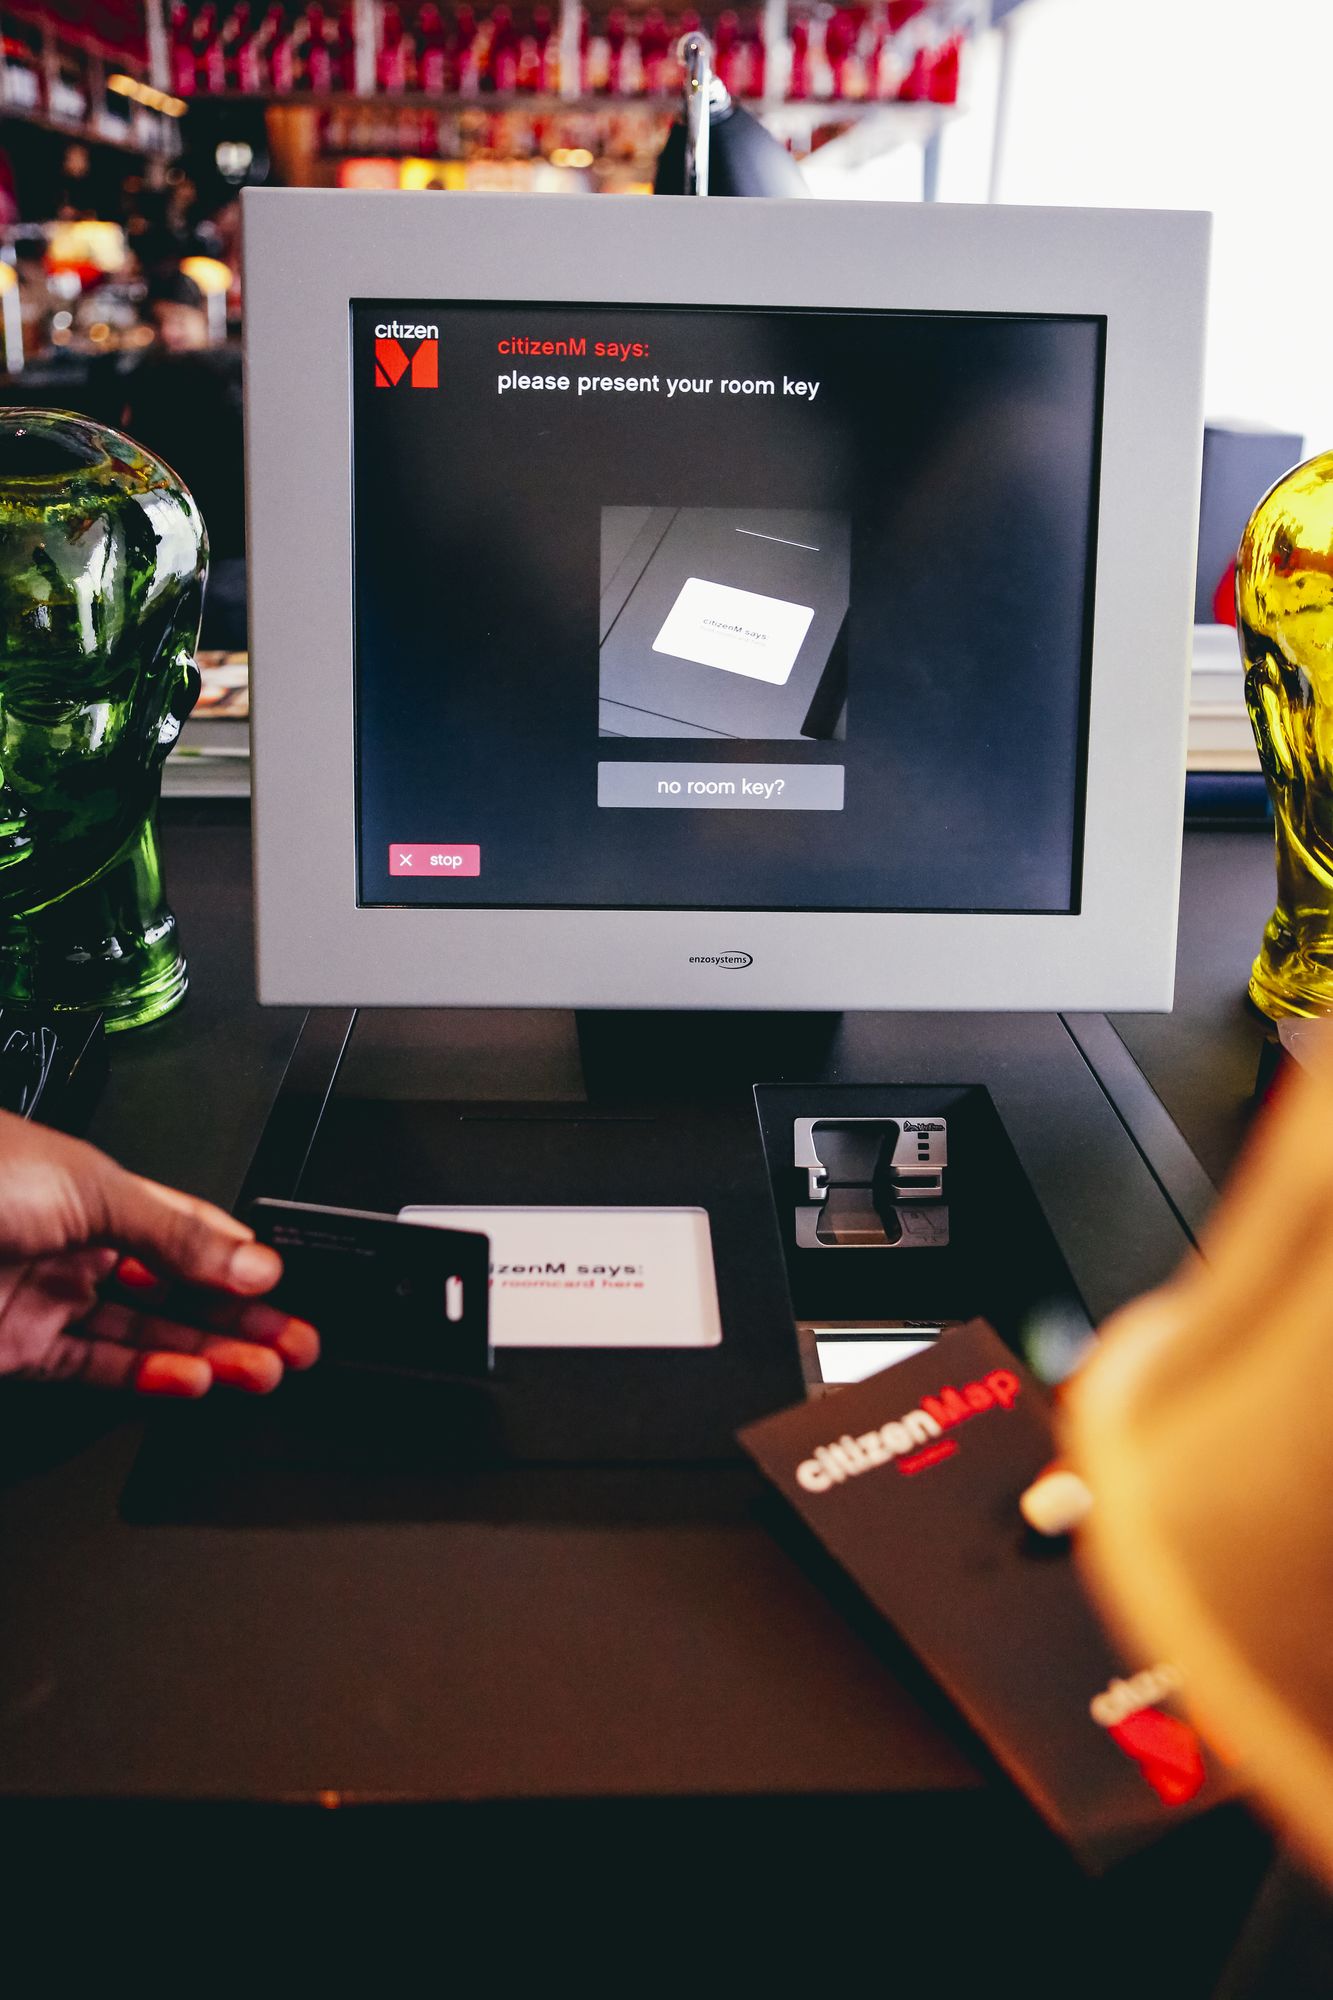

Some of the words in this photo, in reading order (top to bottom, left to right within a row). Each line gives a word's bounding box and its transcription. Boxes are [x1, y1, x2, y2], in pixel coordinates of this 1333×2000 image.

[374, 320, 439, 339] citizen
[497, 336, 586, 357] citizenM
[594, 341, 649, 363] says:
[497, 369, 570, 395] please
[577, 374, 660, 396] present
[666, 378, 713, 398] your
[720, 378, 775, 395] room
[782, 375, 820, 401] key
[657, 781, 682, 794] no
[687, 781, 736, 795] room
[741, 778, 785, 799] key?
[429, 853, 463, 870] stop
[688, 955, 747, 966] enzosystems
[488, 1262, 566, 1274] izenM
